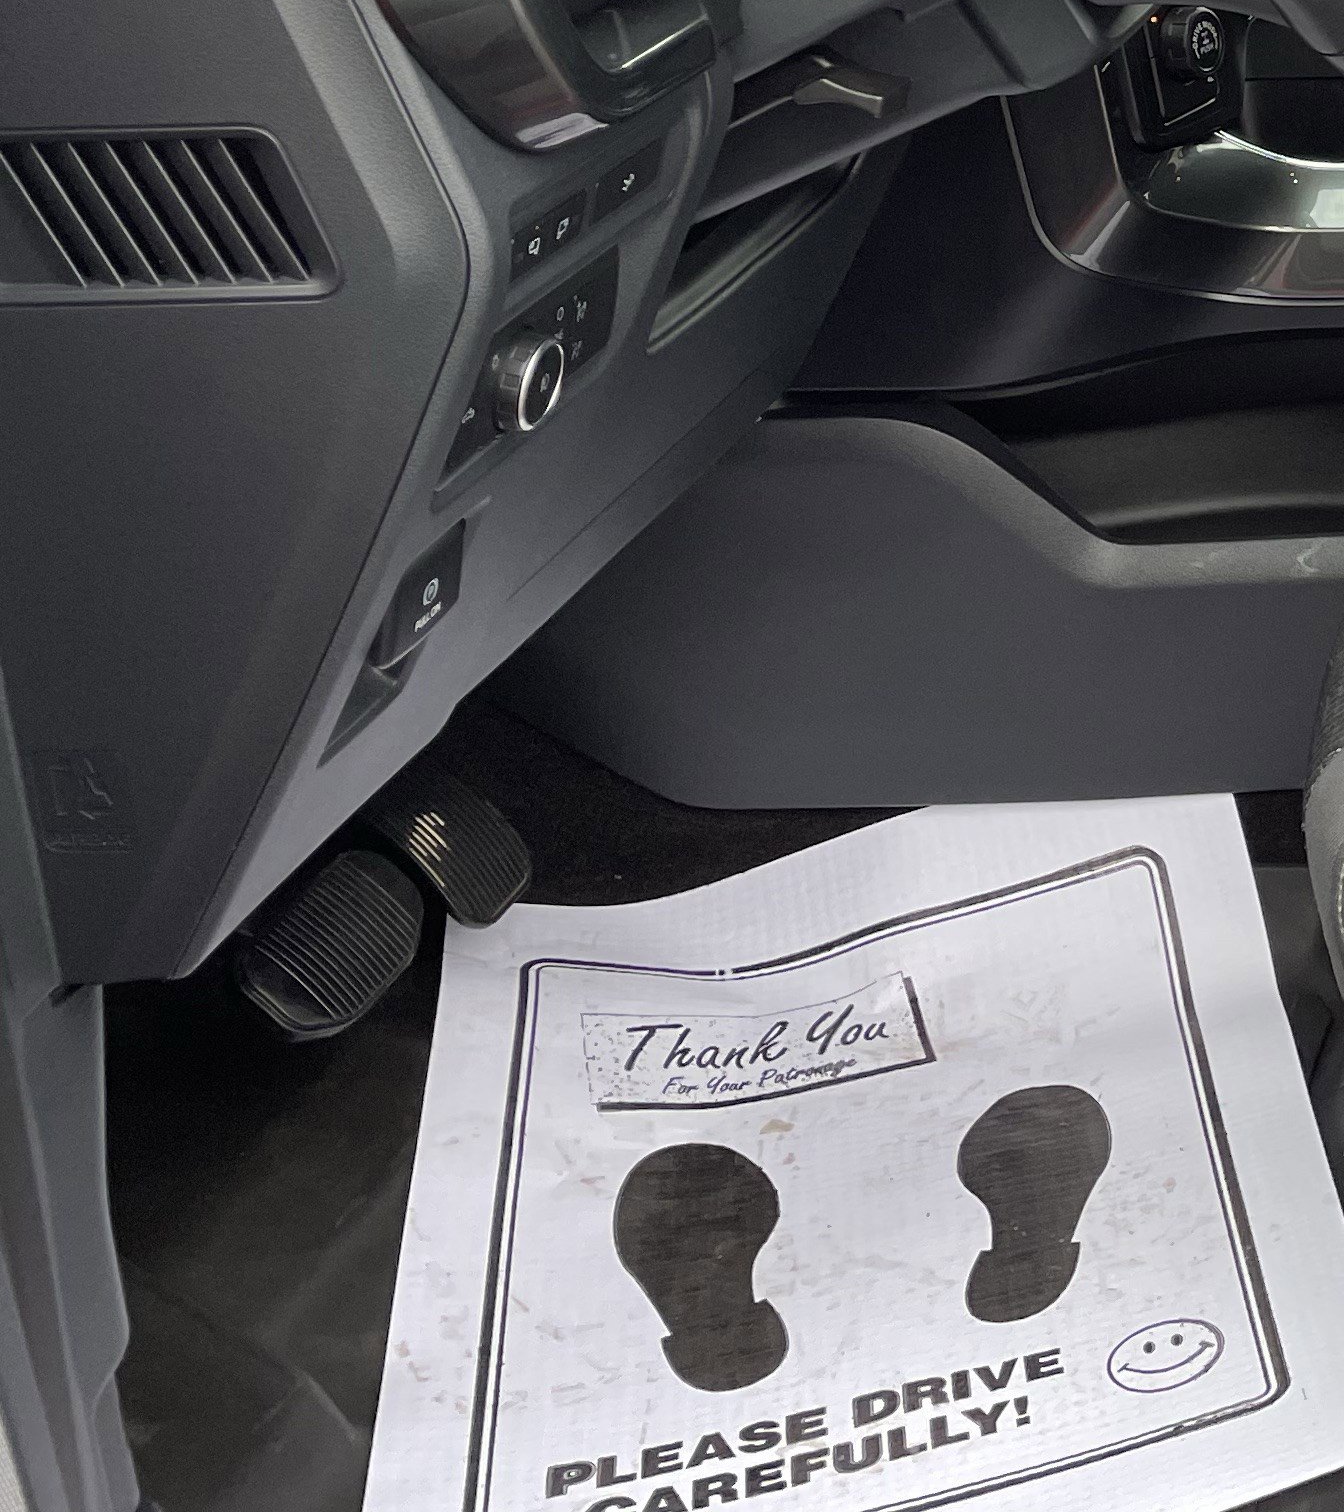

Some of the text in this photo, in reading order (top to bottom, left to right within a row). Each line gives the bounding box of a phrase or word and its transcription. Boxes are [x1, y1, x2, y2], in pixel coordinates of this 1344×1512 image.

[624, 1003, 889, 1072] Thank You
[662, 1057, 858, 1095] For Your Patronage
[545, 1347, 1065, 1499] PLEASE DRIVE
